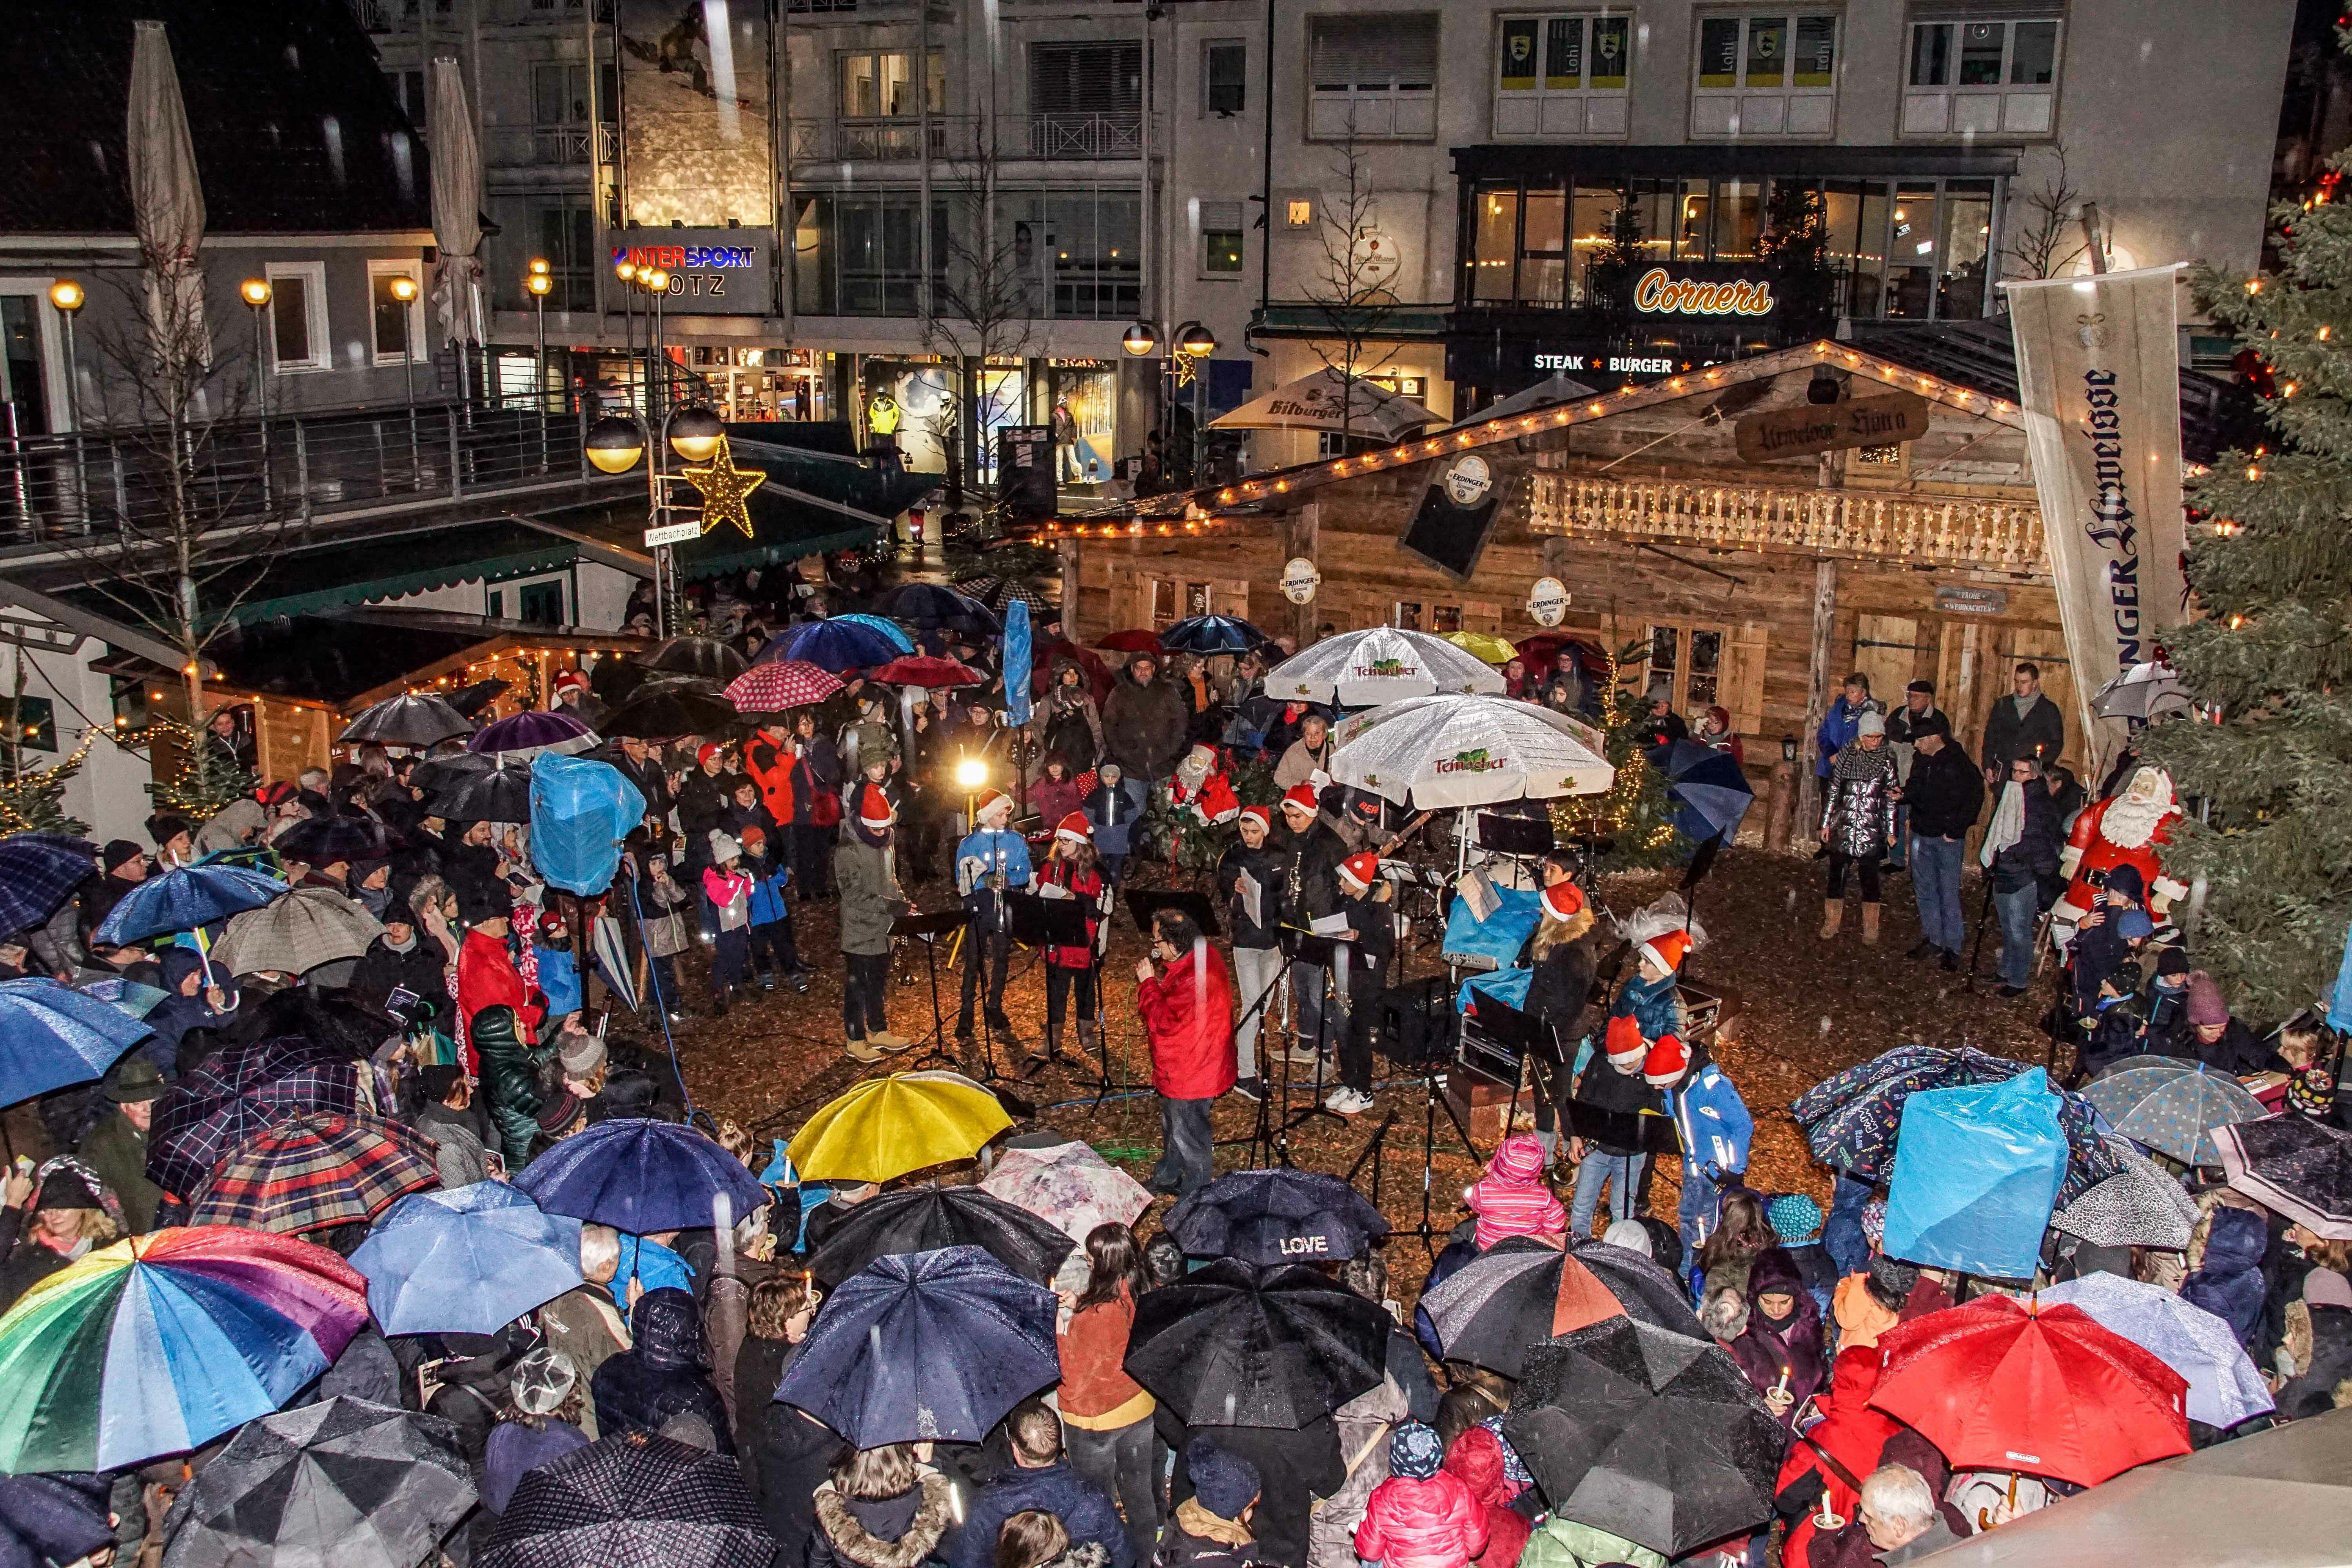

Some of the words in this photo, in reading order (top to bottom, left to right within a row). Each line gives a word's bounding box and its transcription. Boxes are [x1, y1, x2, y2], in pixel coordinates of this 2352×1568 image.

[629, 246, 755, 268] INTERSPORT
[634, 274, 725, 296] OTZ
[1635, 268, 1773, 316] Corners
[1534, 355, 1584, 370] STEAK
[1609, 357, 1672, 373] BURGER
[1267, 400, 1343, 419] Bitburger
[1453, 473, 1484, 488] ERDINGER
[648, 526, 697, 542] Wettbachplatz
[1285, 577, 1314, 587] ERDINGER
[1532, 597, 1564, 608] ERDINGER
[1949, 603, 1991, 612] WEIHNACHTEN
[1279, 1236, 1328, 1255] LOVE
